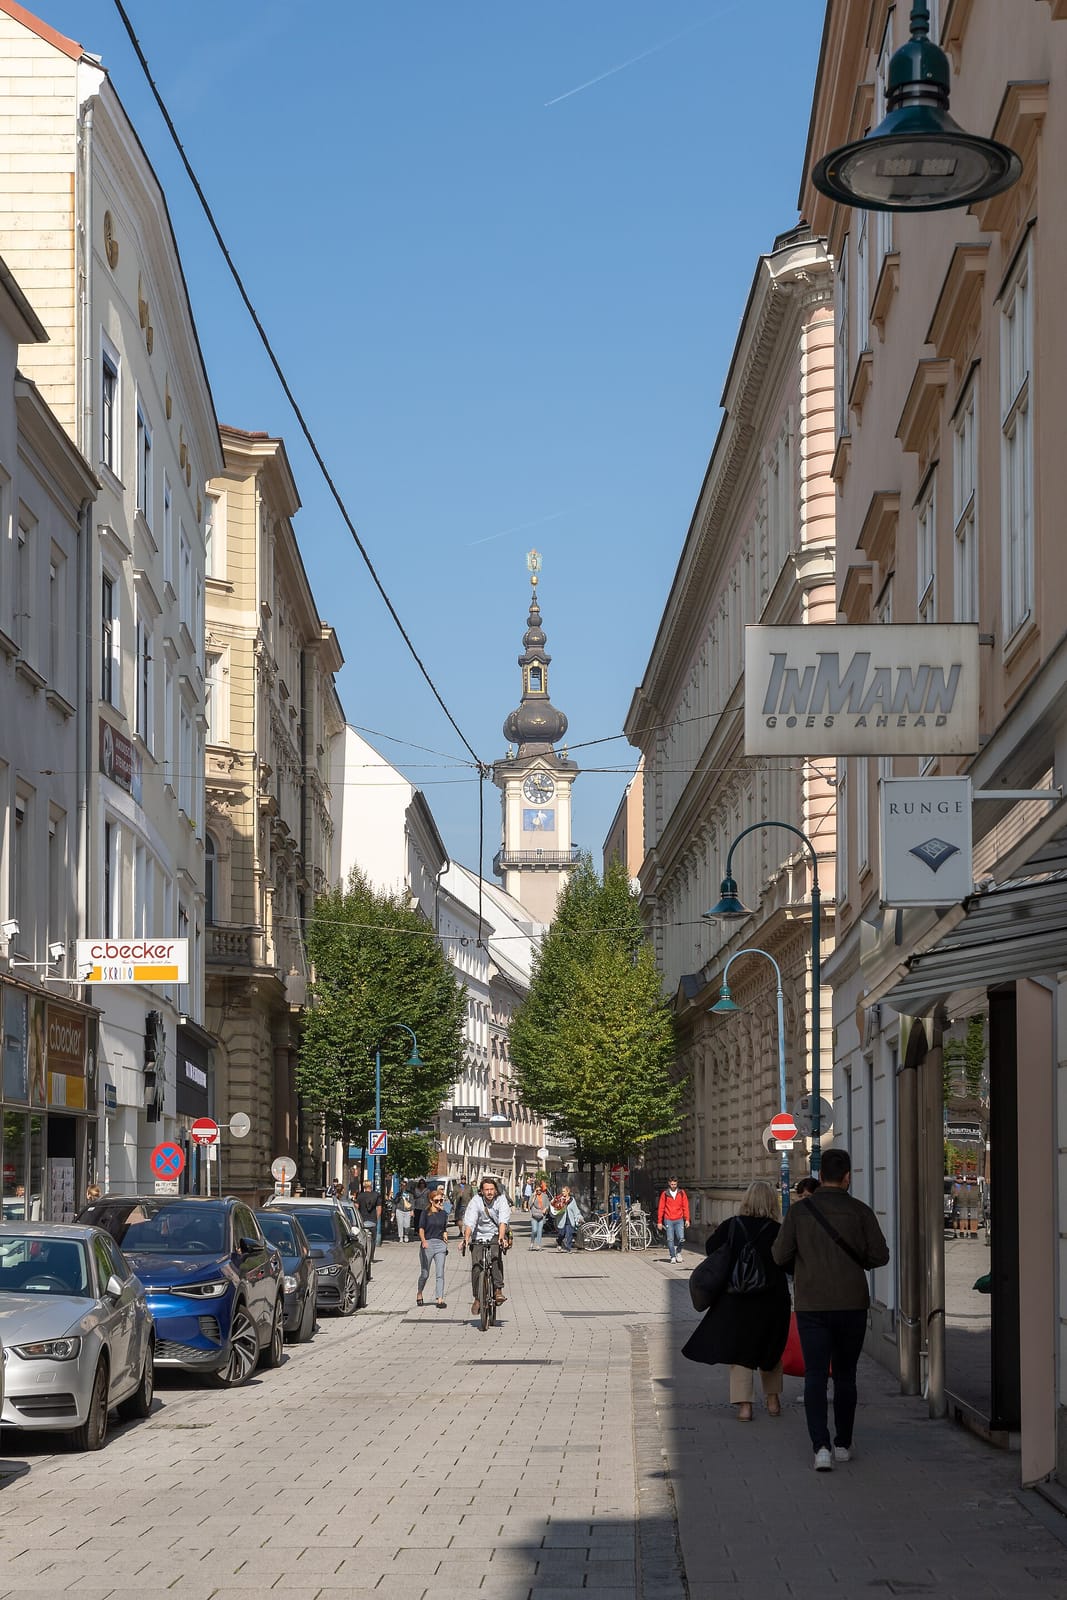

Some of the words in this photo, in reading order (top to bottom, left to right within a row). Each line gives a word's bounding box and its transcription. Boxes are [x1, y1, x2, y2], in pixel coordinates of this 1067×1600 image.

[766, 715, 835, 728] GOES
[855, 714, 947, 728] AHEAD
[889, 801, 963, 815] RUNGE
[91, 942, 174, 959] c.becker
[50, 1018, 82, 1056] c.becker
